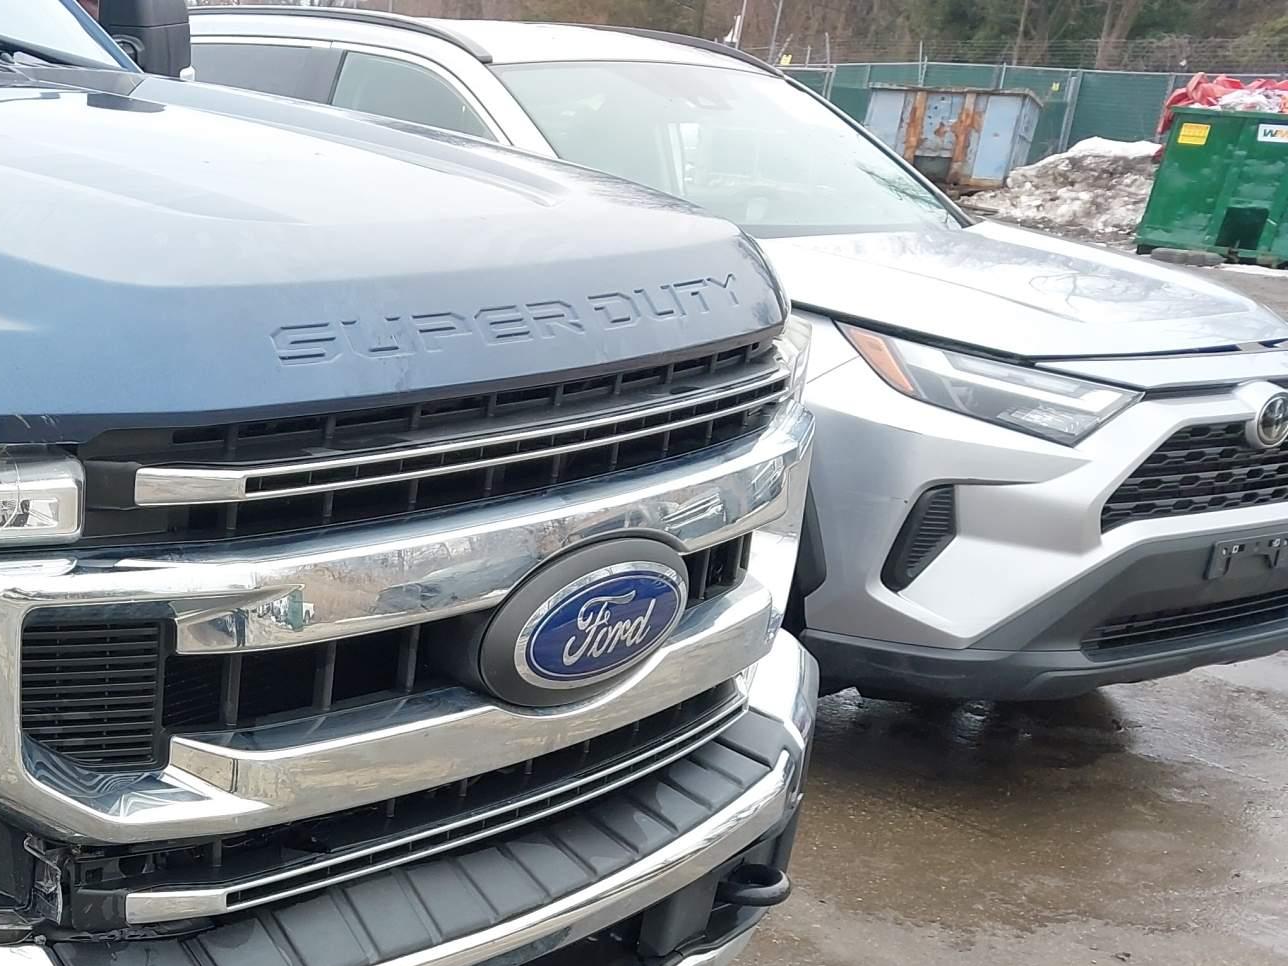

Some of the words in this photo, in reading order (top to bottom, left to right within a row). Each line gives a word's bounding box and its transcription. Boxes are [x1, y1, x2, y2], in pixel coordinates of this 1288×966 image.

[270, 299, 585, 367] SUPER
[587, 272, 741, 327] DUTY
[562, 589, 657, 666] Ford
